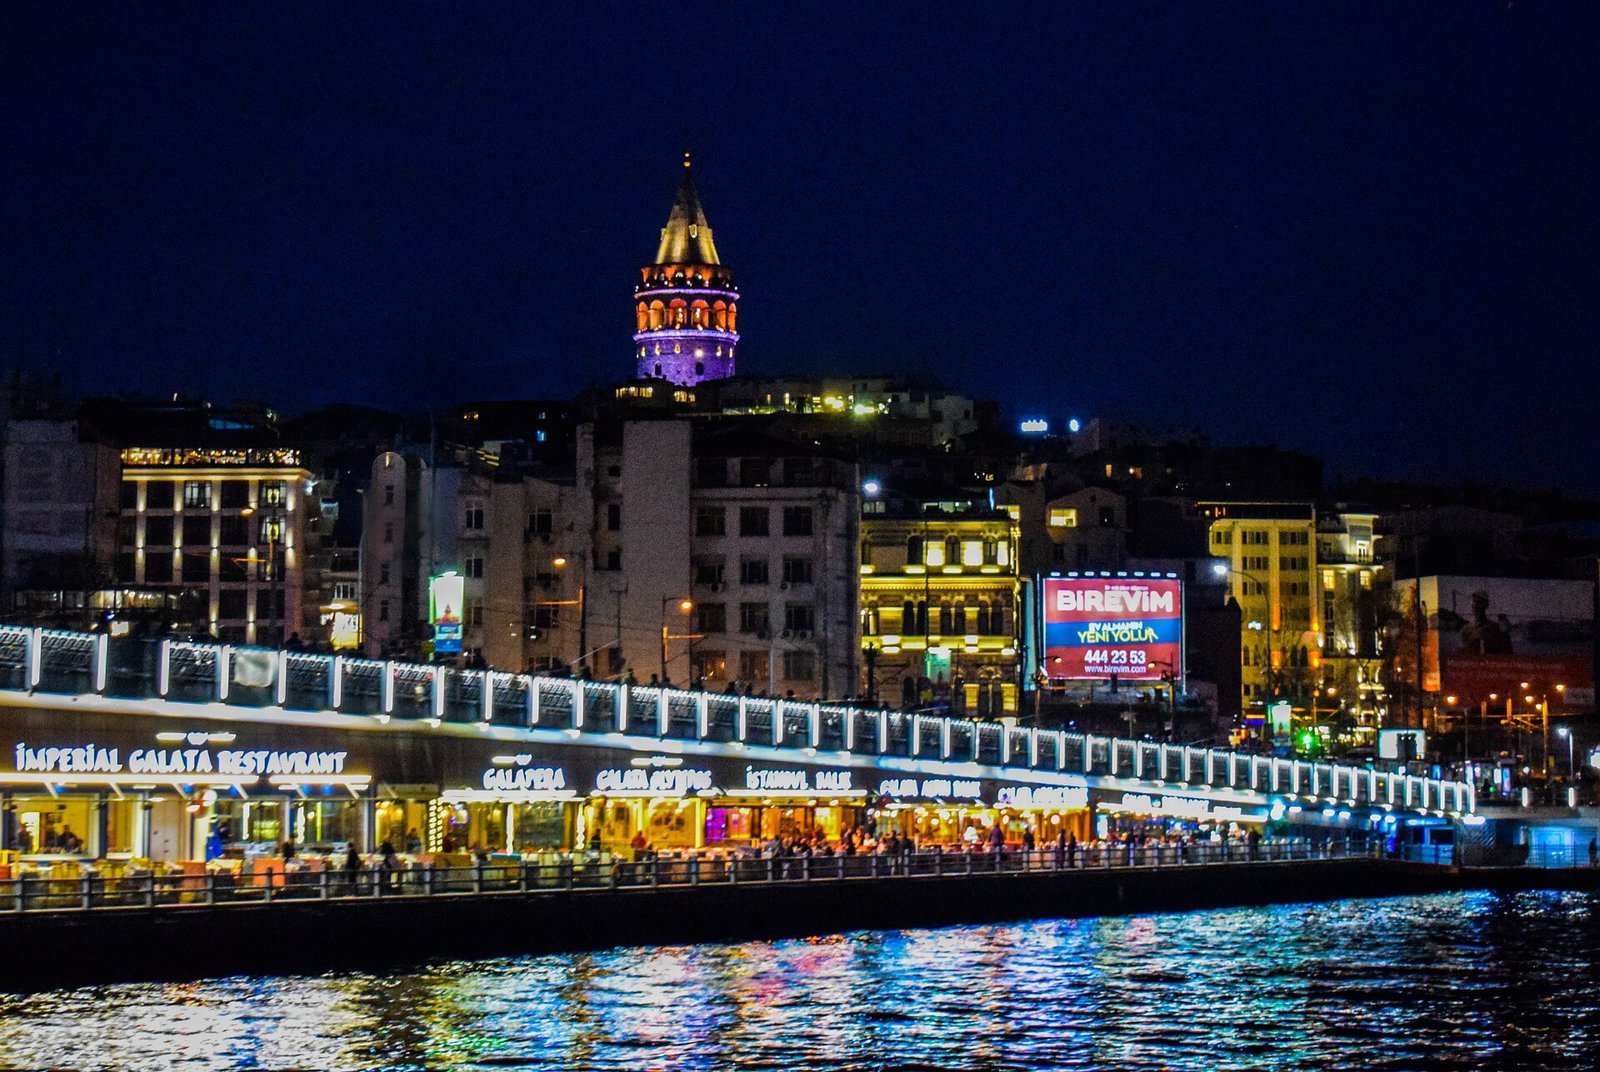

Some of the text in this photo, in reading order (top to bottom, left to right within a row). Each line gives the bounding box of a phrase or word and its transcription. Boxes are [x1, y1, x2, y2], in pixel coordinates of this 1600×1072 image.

[1078, 630, 1109, 643] YENİ
[1084, 649, 1146, 665] 444 23 53
[1084, 664, 1146, 674] www.birevim.com
[129, 749, 213, 773] GALATA
